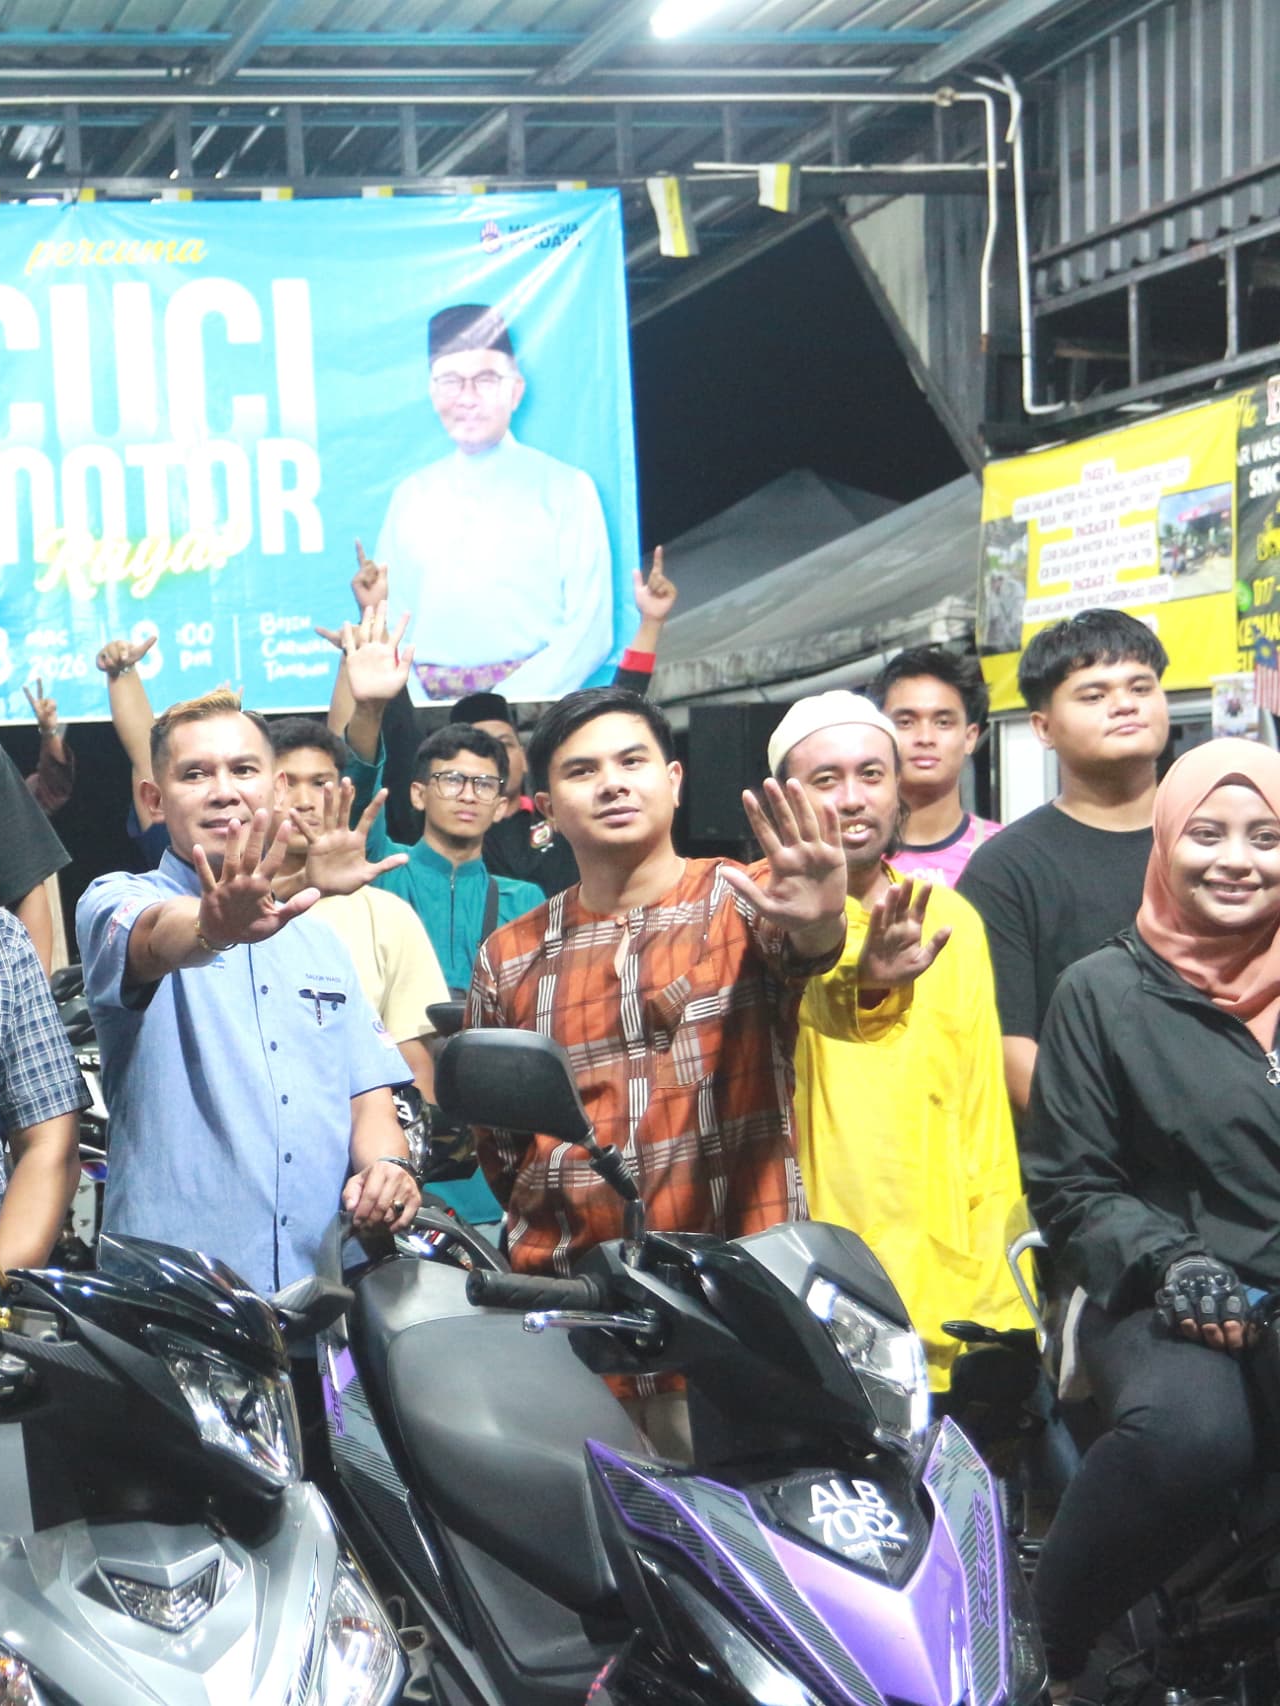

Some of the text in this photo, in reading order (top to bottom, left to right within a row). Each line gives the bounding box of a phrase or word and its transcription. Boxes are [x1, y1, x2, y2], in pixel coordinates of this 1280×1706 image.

[24, 237, 209, 276] percuma
[27, 652, 88, 681] 2026
[810, 1479, 886, 1514] ALB
[808, 1507, 909, 1548] 7052
